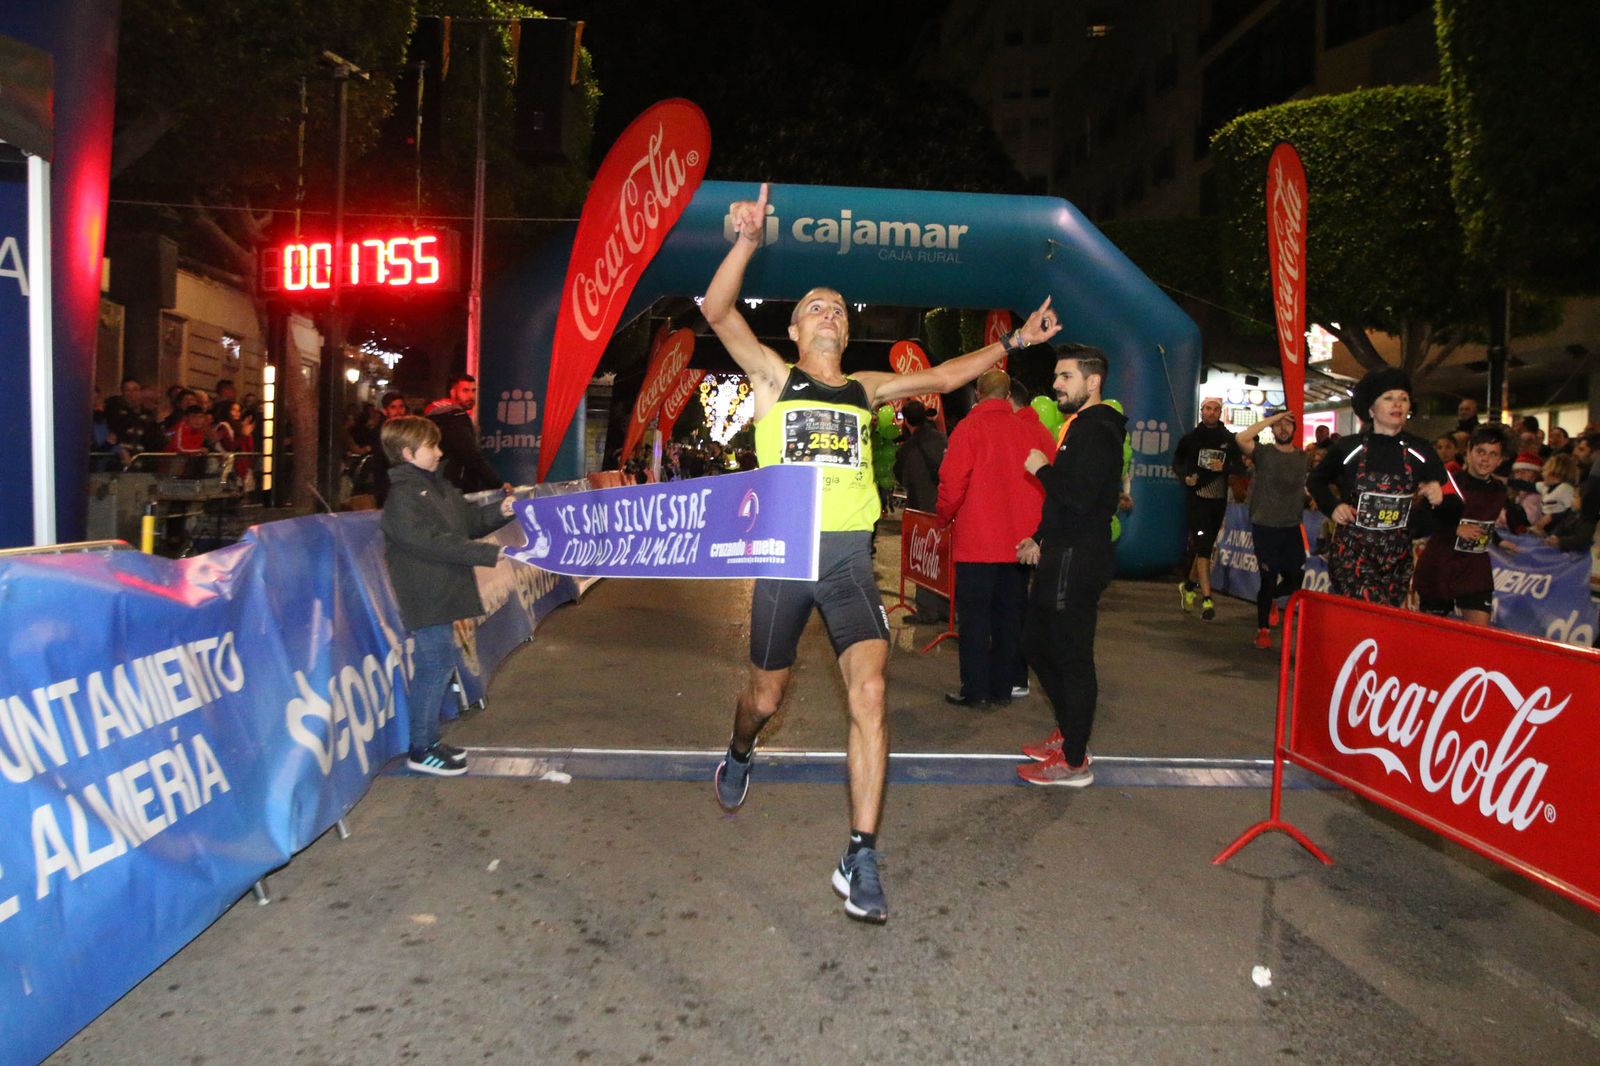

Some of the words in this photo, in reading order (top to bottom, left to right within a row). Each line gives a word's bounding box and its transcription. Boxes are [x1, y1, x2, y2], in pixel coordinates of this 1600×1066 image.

[792, 209, 969, 255] cajamar
[878, 249, 914, 262] CAJA
[917, 250, 963, 264] RURAL
[808, 433, 849, 452] 2534
[584, 502, 609, 535] SAN
[614, 488, 713, 533] SILVESTRE
[1378, 510, 1399, 520] 828
[559, 536, 614, 567] CIUDAD
[609, 534, 635, 567] DE
[630, 531, 701, 567] ALMERIA
[0, 631, 245, 784] UNTAMIENTO
[31, 726, 231, 901] ALMERÍA
